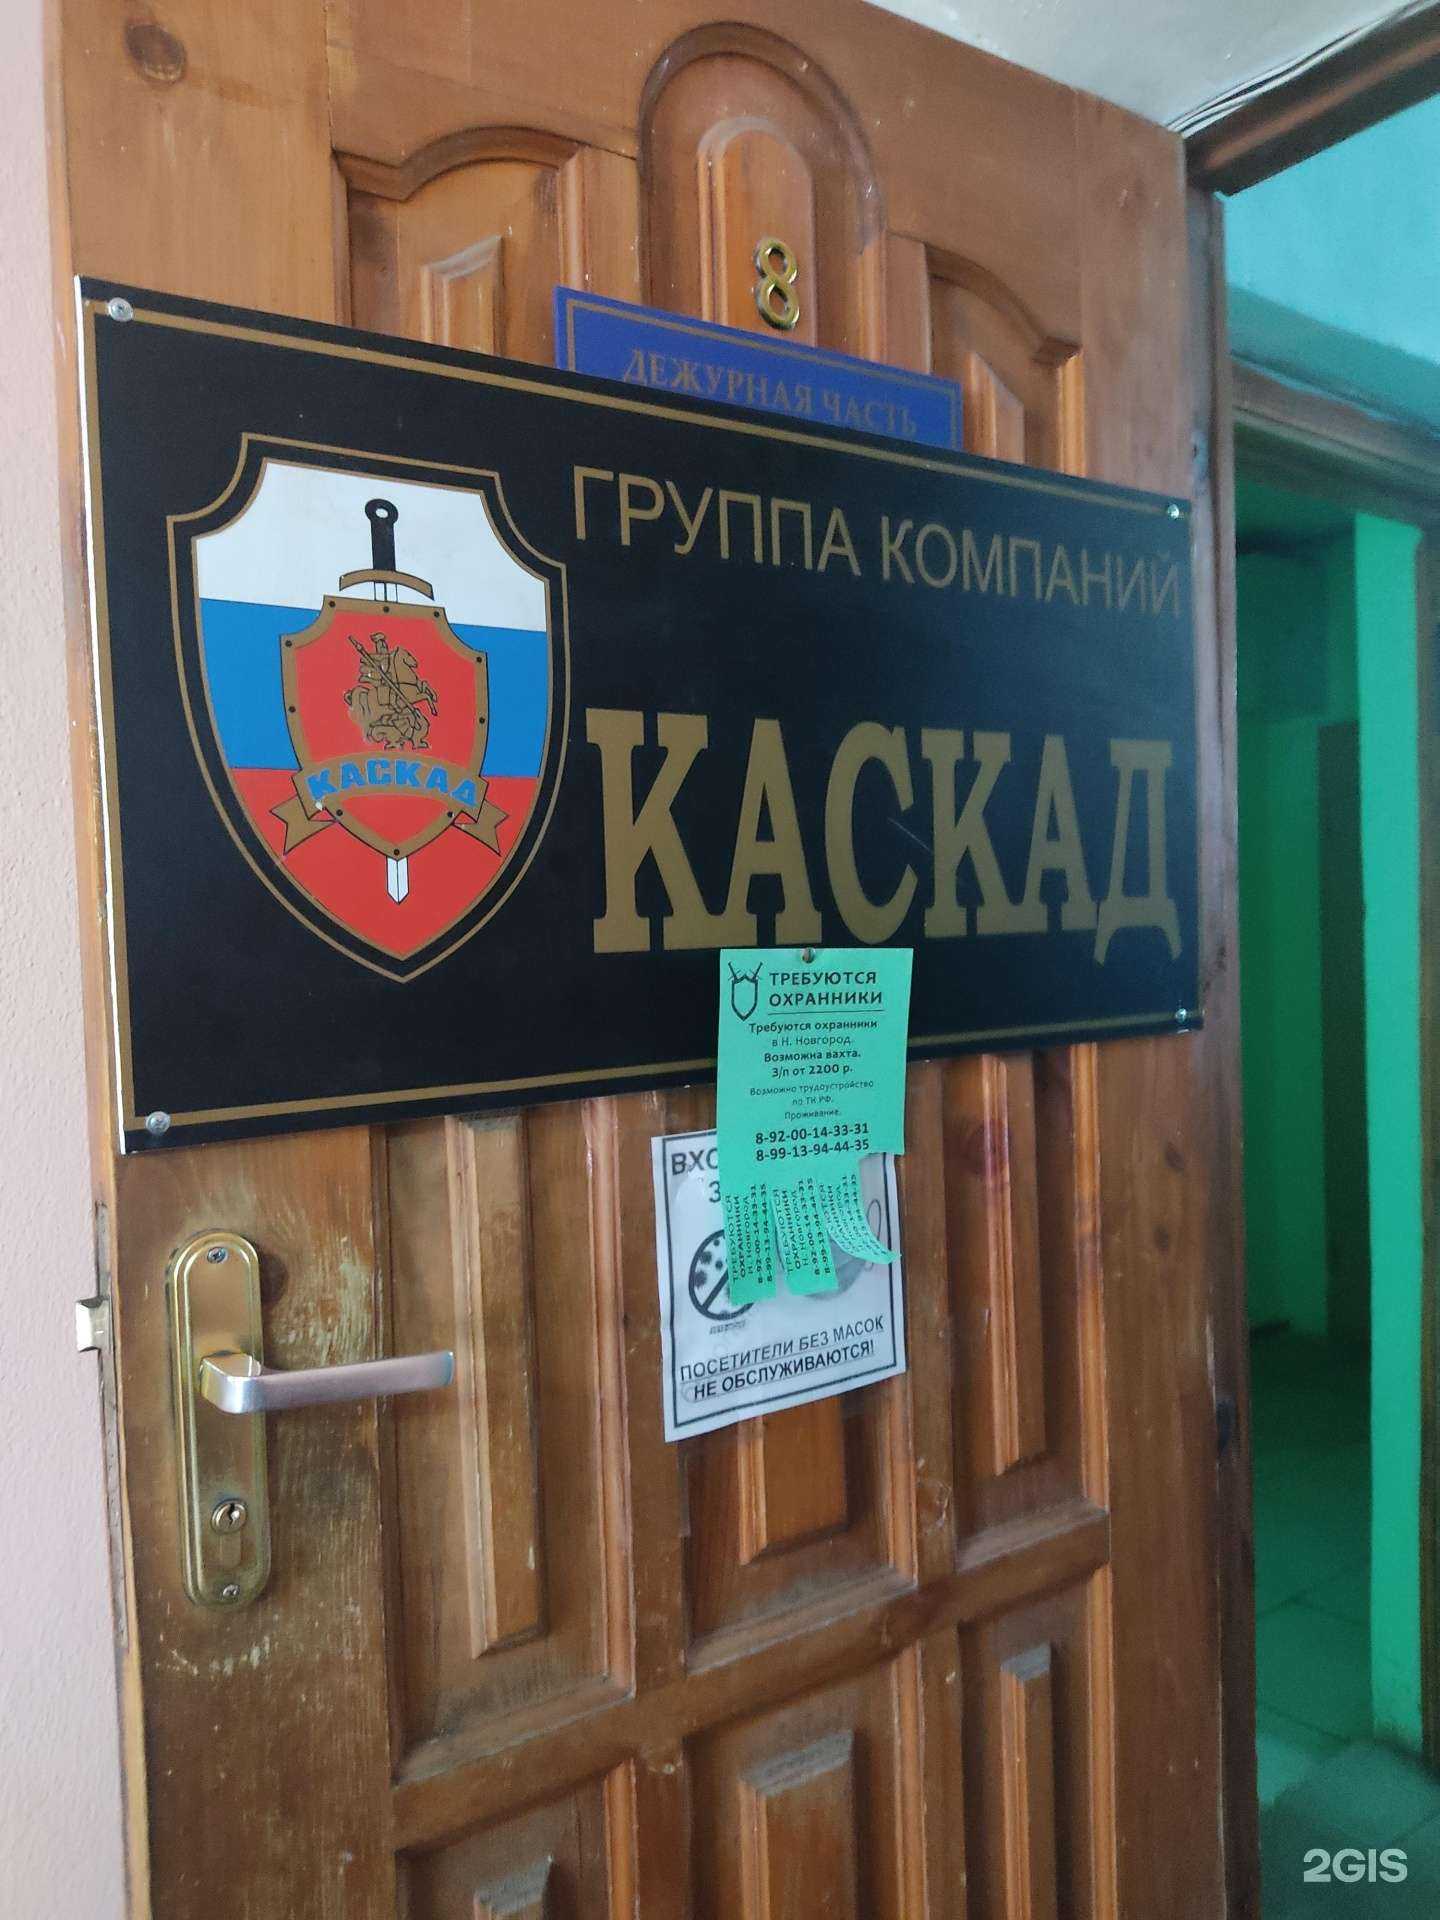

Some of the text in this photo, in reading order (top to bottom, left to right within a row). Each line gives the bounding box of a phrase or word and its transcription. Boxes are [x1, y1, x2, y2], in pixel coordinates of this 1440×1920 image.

[754, 236, 800, 331] 8
[623, 347, 917, 438] ДЕЖУРНАЯ ЧАСТЬ
[573, 465, 1180, 618] ГРУППА КОМПАНИЙ
[305, 757, 481, 808] КАСКАД
[585, 707, 1183, 966] КАСКАД
[769, 971, 877, 986] ТРЕБУЮТСЯ
[769, 991, 883, 1007] ОХРАННИКИ
[749, 1019, 878, 1034] Требуются охранники
[771, 1039, 778, 1047] в
[781, 1037, 792, 1046] Н.
[763, 1049, 861, 1063] Возможна вахта.
[792, 1067, 806, 1077] от
[808, 1064, 840, 1075] 2200
[842, 1065, 853, 1077] р.
[749, 1079, 874, 1097] Возможно трудоустройство
[806, 1096, 817, 1105] ТК
[755, 1122, 869, 1145] 8-92-00-14-33-31
[671, 1147, 718, 1176] ВХО
[755, 1138, 870, 1162] 8-99-13-94-44-35
[680, 1315, 885, 1382] ПОСЕТИТЕЛИ БЕЗ МАСОК
[693, 1338, 876, 1401] НЕ ОБСЛУЖИВАЮТСЯ!
